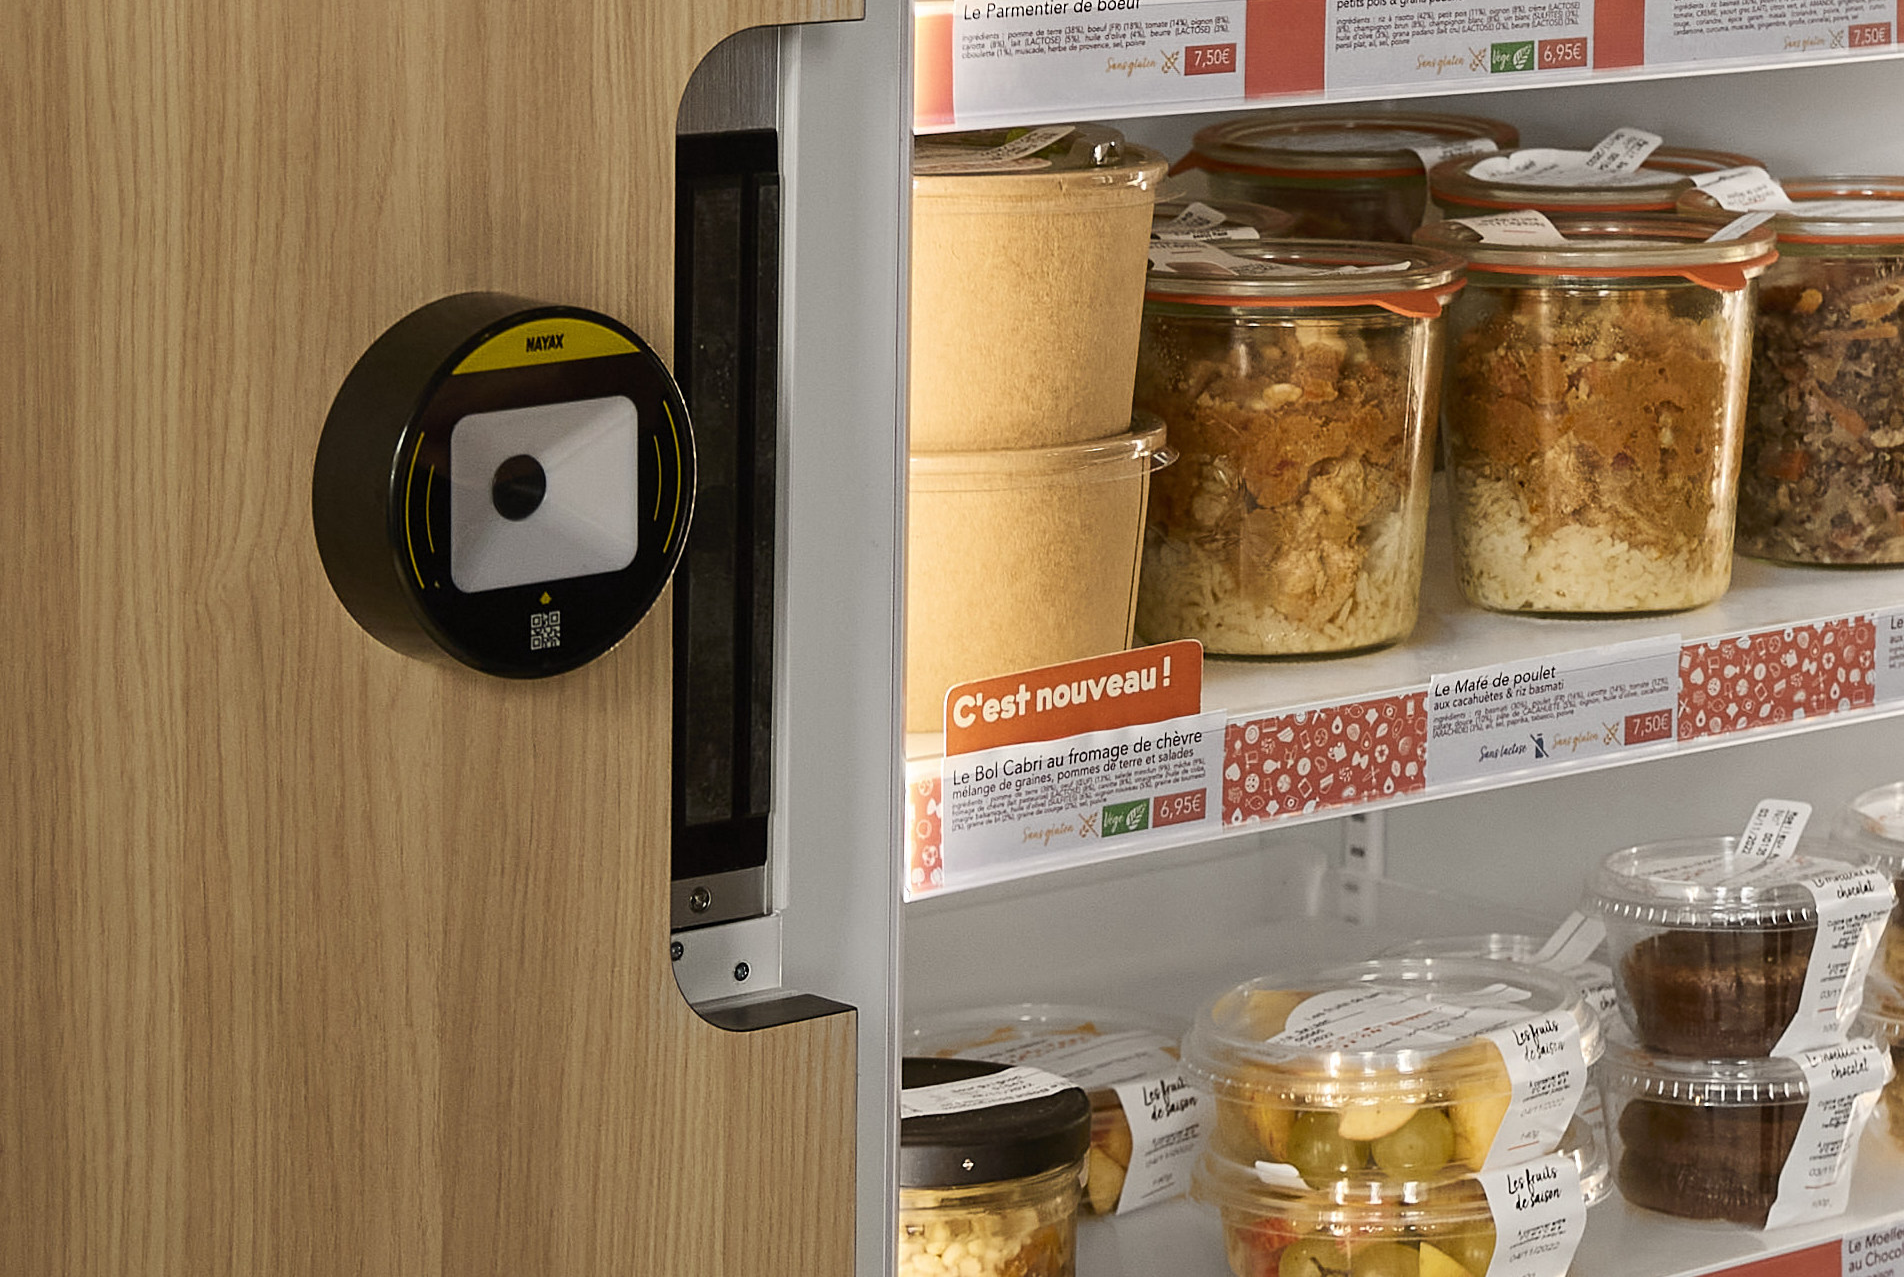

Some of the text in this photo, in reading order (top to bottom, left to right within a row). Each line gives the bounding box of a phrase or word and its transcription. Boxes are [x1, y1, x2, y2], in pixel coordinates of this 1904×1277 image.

[964, 4, 981, 21] Le
[986, 0, 1068, 19] Parmentier
[1854, 28, 1885, 45] 7,50€
[1195, 48, 1230, 67] 7,50€
[1544, 43, 1582, 64] 6,95€
[525, 334, 564, 352] NAYAX
[1891, 616, 1903, 630] Le
[1890, 633, 1903, 644] aux
[1435, 665, 1556, 698] Le Mafé de poulet
[953, 656, 1171, 728] C'est nouveau !
[1434, 680, 1564, 712] aux cacahuètes & riz basmati
[1633, 716, 1669, 735] 7,50€
[953, 730, 1202, 786] Le Bol Cabri au fromage de chèvre
[1479, 746, 1499, 763] Sans
[952, 747, 1194, 800] mélange de graines, pommes de terre et salades
[1160, 794, 1201, 819] 6,95€
[1837, 880, 1874, 898] chocolat
[1512, 1020, 1558, 1049] Les fruits
[1525, 1046, 1535, 1062] de
[1507, 1165, 1558, 1194] Les fruits
[1516, 1188, 1562, 1211] de saison
[1849, 1240, 1861, 1254] Le
[1849, 1260, 1862, 1272] au
